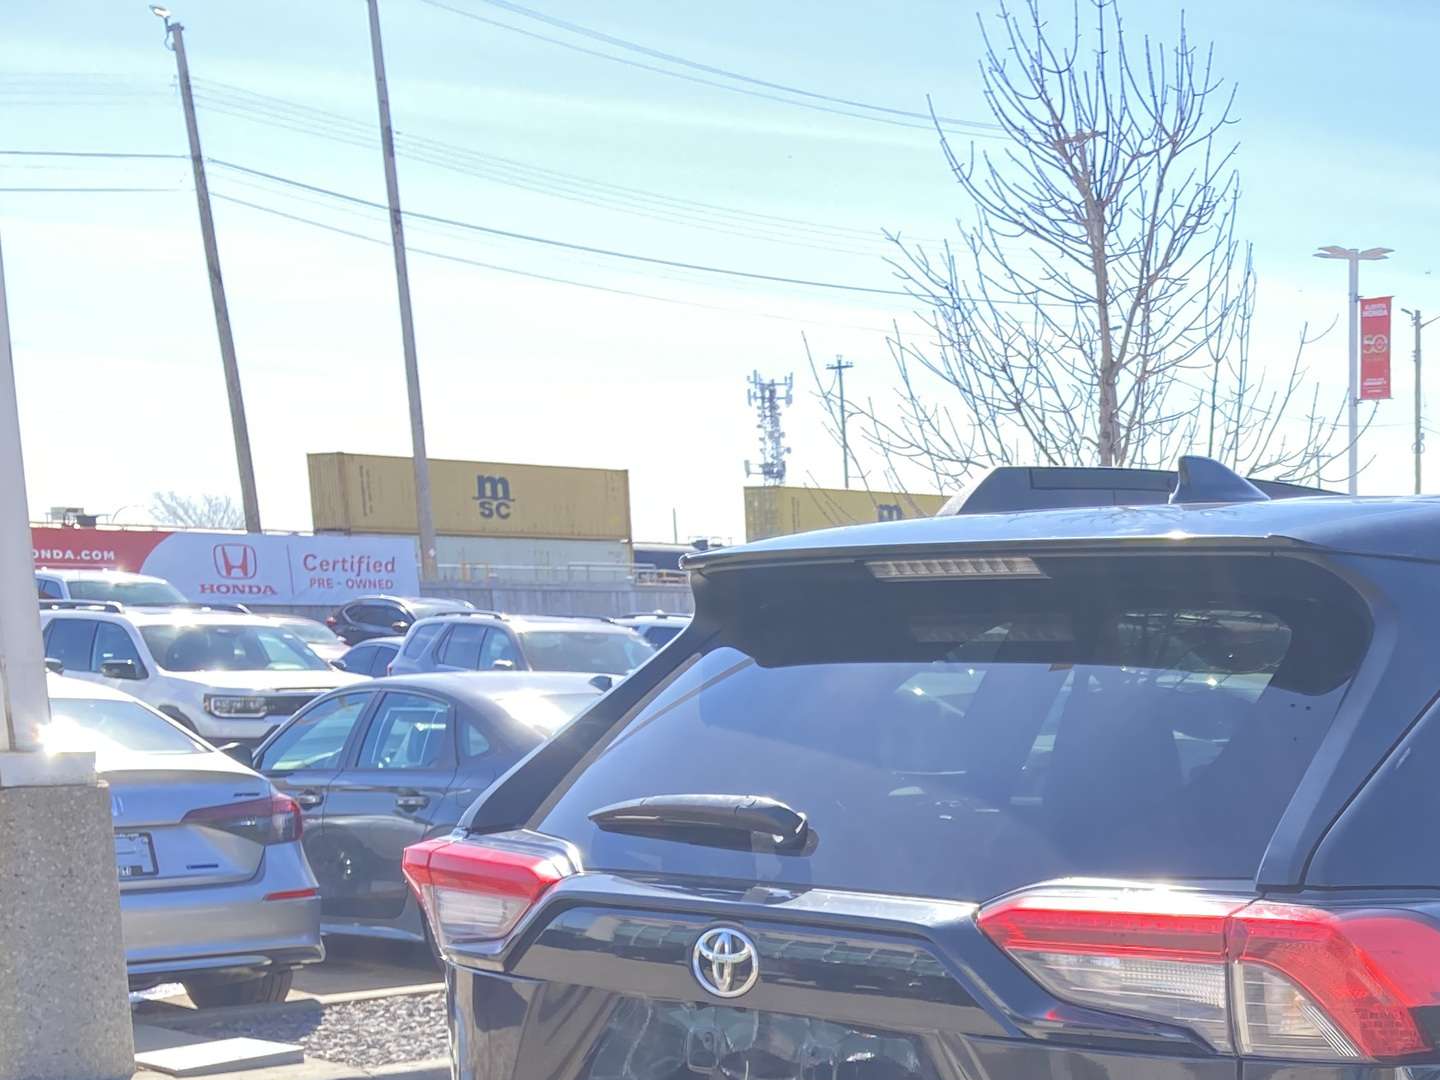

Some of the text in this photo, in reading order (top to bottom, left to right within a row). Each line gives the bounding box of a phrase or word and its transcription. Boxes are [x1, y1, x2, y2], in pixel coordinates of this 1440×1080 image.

[303, 553, 396, 577] Certified
[199, 583, 278, 596] HONDA
[309, 577, 330, 589] PRE
[345, 578, 394, 590] OWNED
